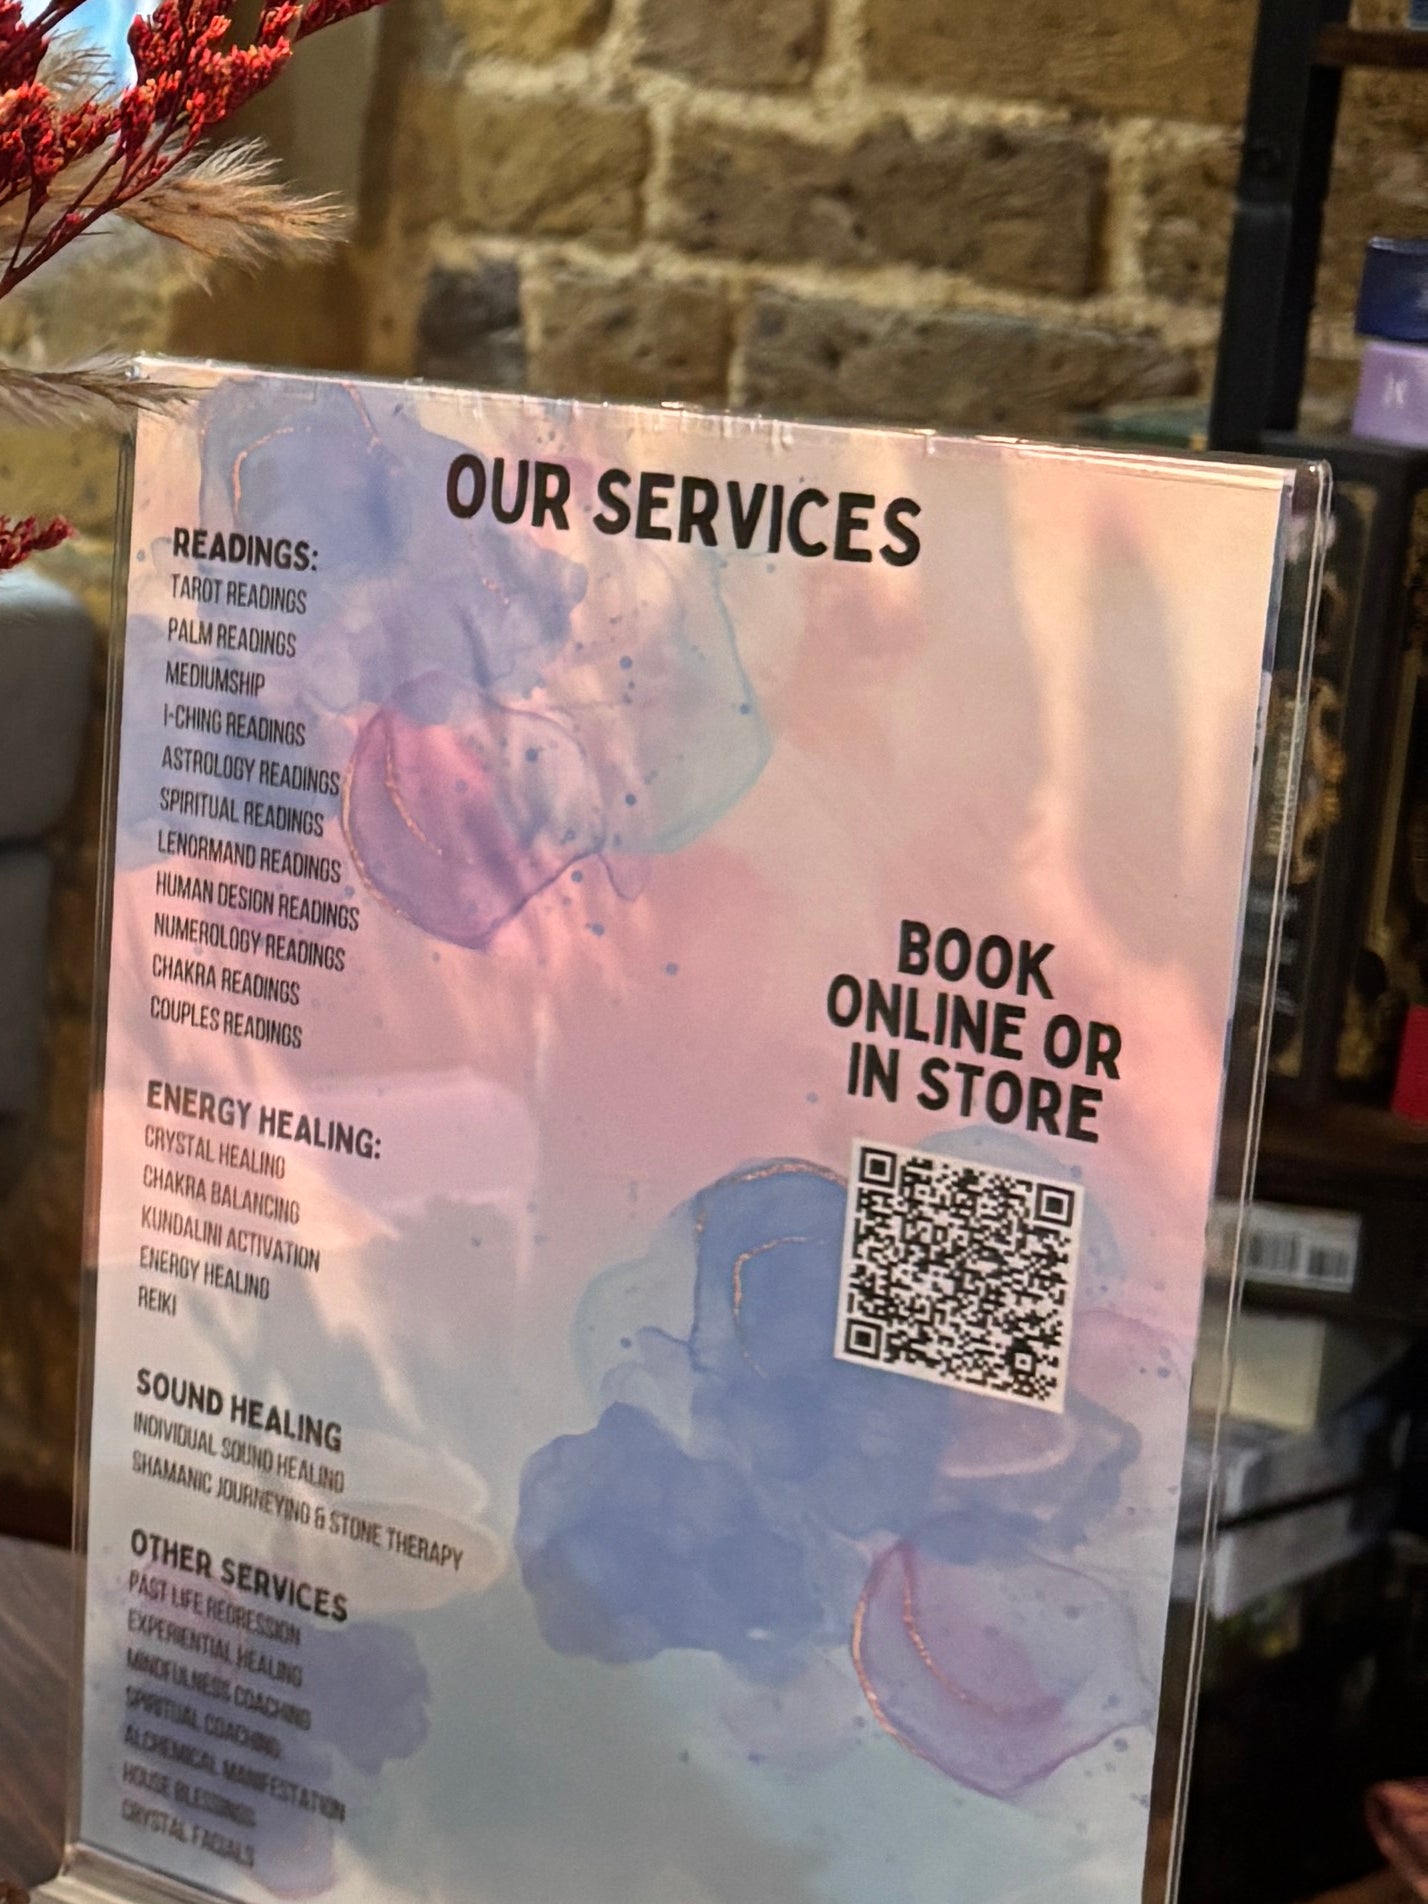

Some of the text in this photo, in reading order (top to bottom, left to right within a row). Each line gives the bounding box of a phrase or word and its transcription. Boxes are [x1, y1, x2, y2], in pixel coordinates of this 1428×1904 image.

[445, 453, 923, 568] OUR SERVICES
[173, 527, 318, 572] READINGS:
[172, 573, 307, 615] TAROT READINGS
[168, 617, 296, 658] PALM READINGS
[165, 661, 265, 697] MEDIUMSHIP
[164, 703, 306, 746] I-CHING READINGS
[162, 746, 340, 796] ASTROLOGY READINGS
[160, 787, 324, 837] SPIRITUAL READINGS
[158, 829, 341, 883] LENORMAND READINGS
[156, 871, 360, 931] HUMAN DESIGN READINGS
[154, 913, 346, 972] NUMEROLOGY READINGS
[898, 919, 1055, 1000] BOOK
[152, 954, 300, 1006] CHAKRA READINGS
[150, 995, 302, 1048] COUPLES READINGS
[827, 973, 1122, 1080] ONLINE OR
[146, 1079, 381, 1159] ENERGY HEALING:
[847, 1041, 1103, 1144] IN STORE
[145, 1124, 286, 1180] CRYSTAL HEALING
[143, 1164, 300, 1225] CHAKRA BALANCING
[141, 1204, 320, 1273] KUNDALINI ACTIVATION
[138, 1285, 177, 1316] REIKI
[140, 1245, 270, 1300] ENERGY HEALING
[136, 1368, 342, 1453] SOUND HEALING
[133, 1410, 345, 1494] INDIVIDUAL SOUND HEALING
[132, 1450, 213, 1494] SHAMANIC
[216, 1477, 311, 1526] JOURNEYING
[329, 1510, 384, 1547] STONE
[386, 1527, 464, 1572] THERAPY
[129, 1569, 167, 1601] PAST
[171, 1585, 204, 1615] LIFE
[130, 1528, 348, 1622] OTHER SERVICES
[127, 1607, 303, 1688] EXPERIENTIAL HEALING
[234, 1685, 312, 1731] COACHING
